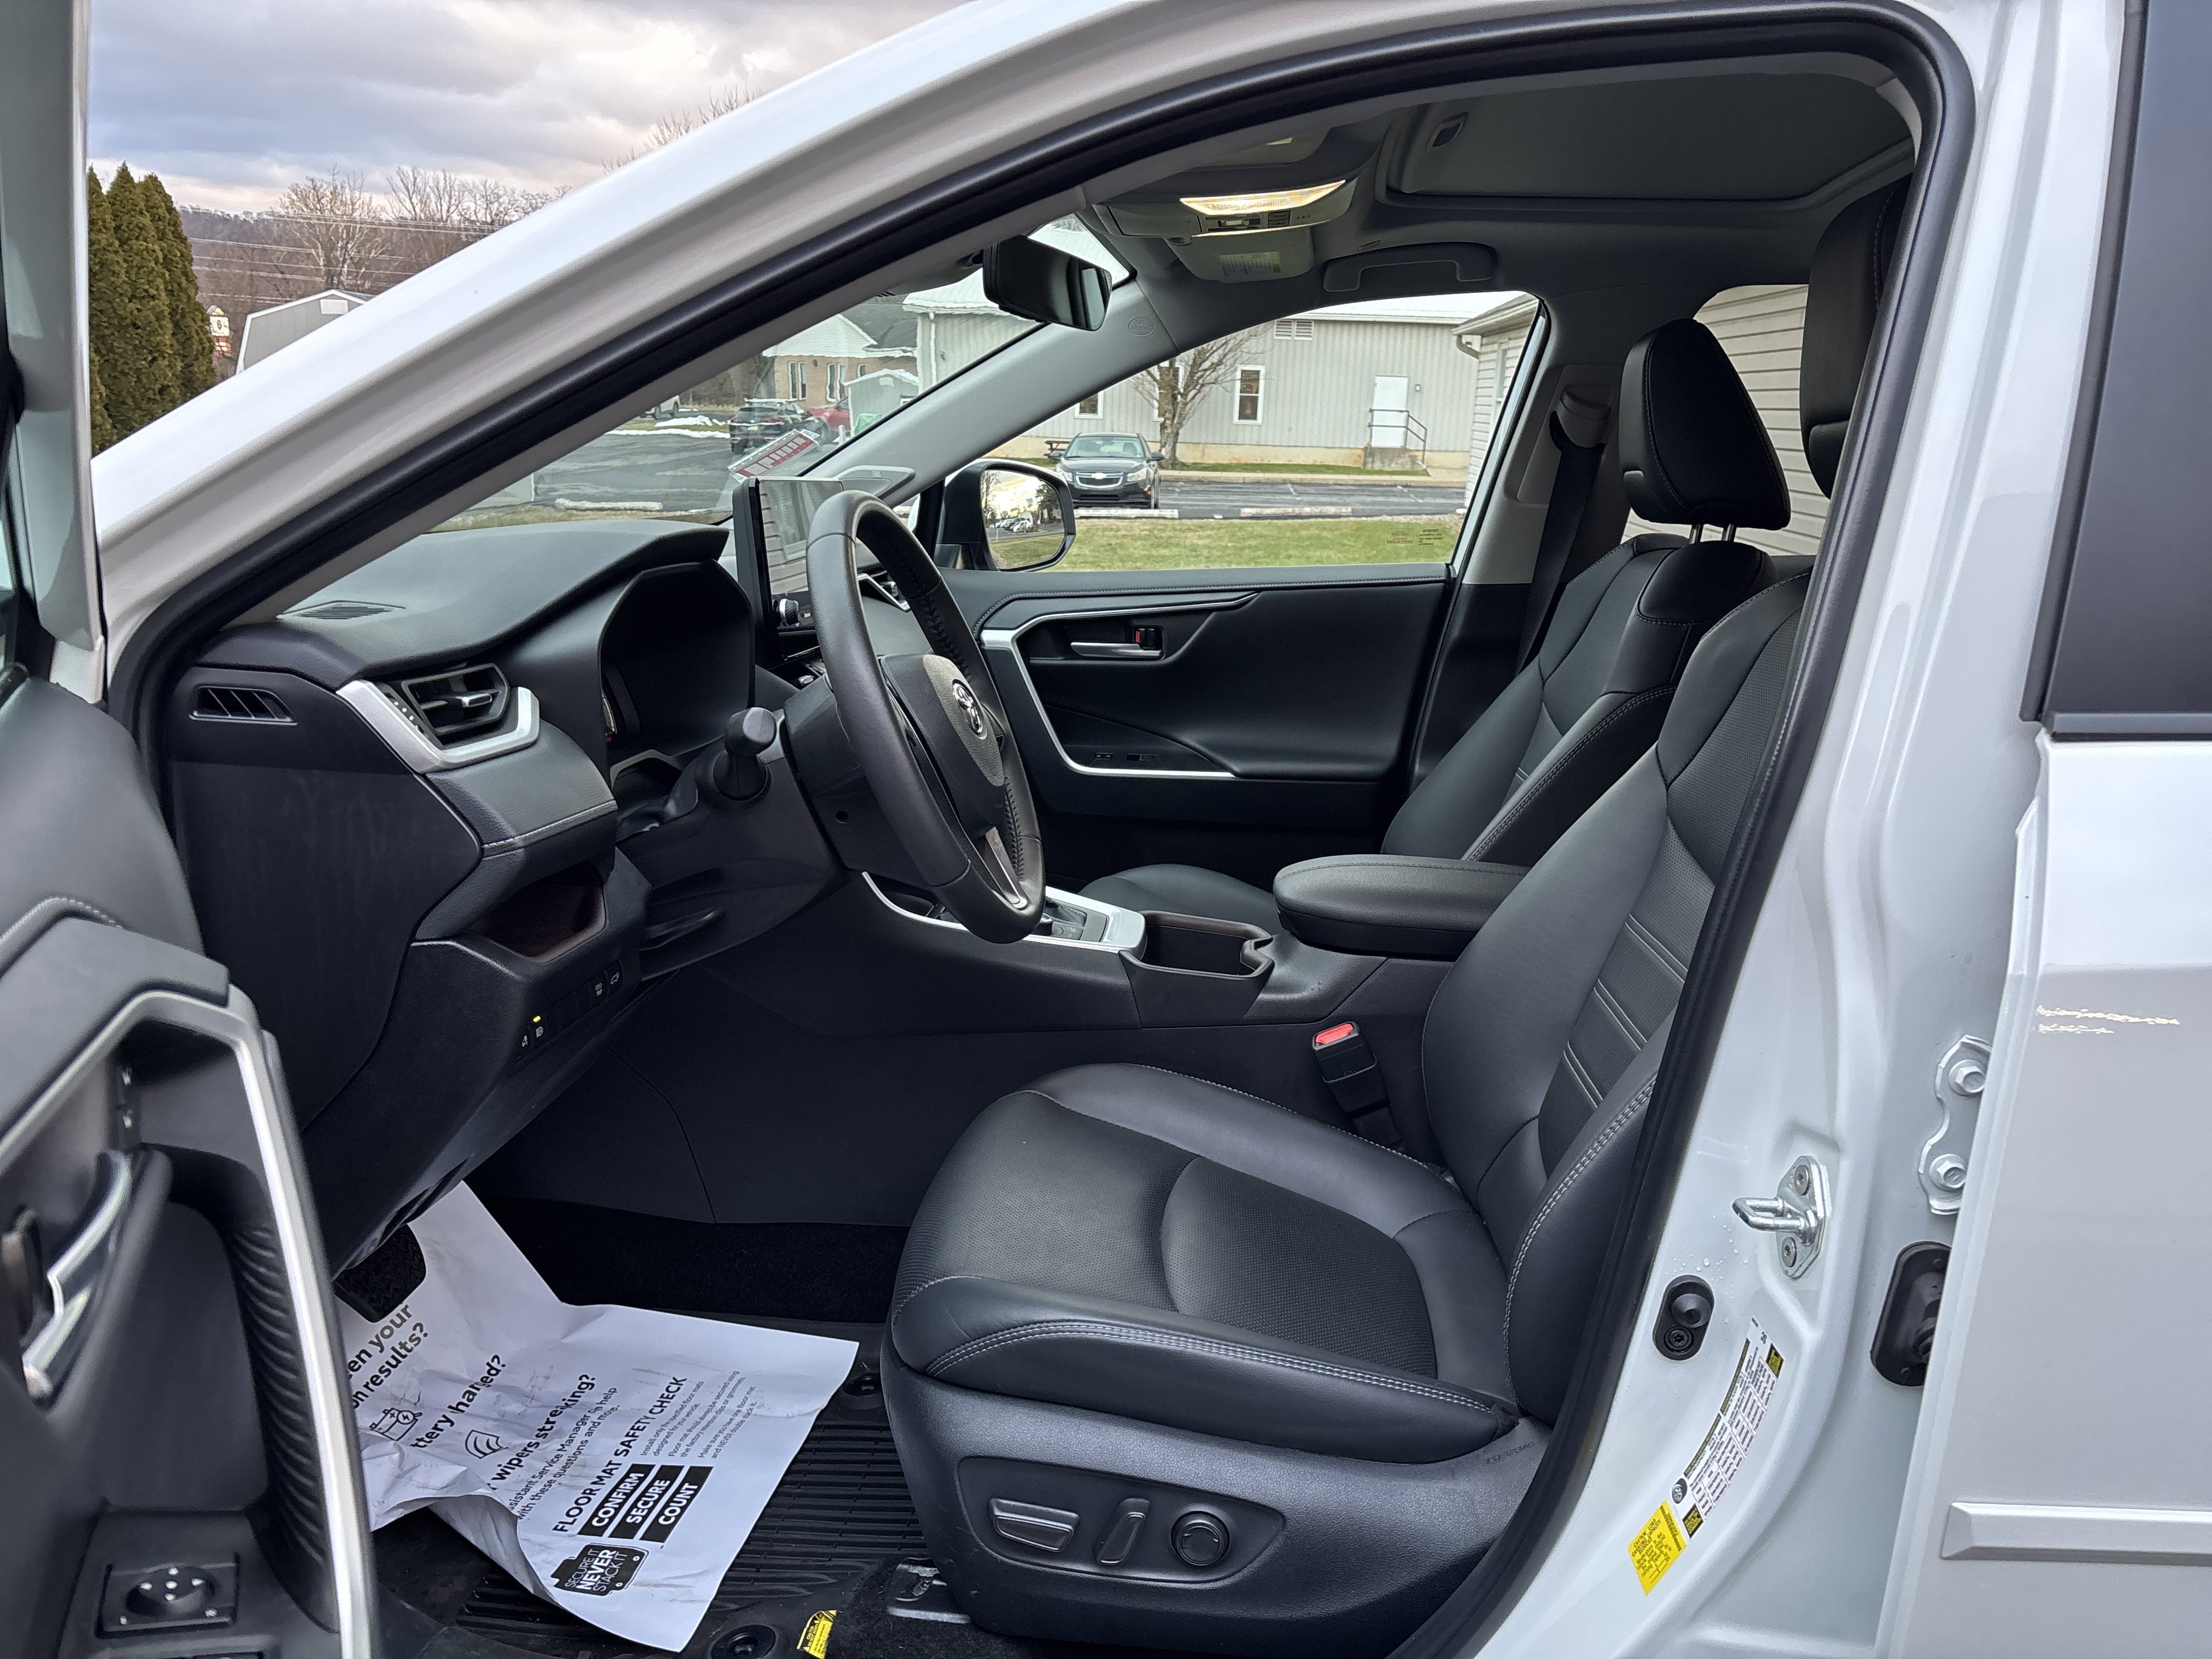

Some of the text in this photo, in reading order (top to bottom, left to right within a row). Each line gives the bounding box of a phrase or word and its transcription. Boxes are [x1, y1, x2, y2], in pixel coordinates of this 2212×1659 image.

[347, 1304, 412, 1380] en your
[363, 1322, 428, 1393] results?
[447, 1355, 506, 1414] hared?
[532, 1454, 563, 1479] Service
[556, 1414, 591, 1452] Manager
[596, 1387, 618, 1404] help
[552, 1376, 687, 1532] FLOOR MAT SAFETY CHECK
[640, 1438, 656, 1455] Install
[491, 1441, 540, 1481] wipers
[517, 1503, 536, 1520] with
[529, 1479, 556, 1500] these
[552, 1440, 589, 1478] questions
[584, 1421, 602, 1437] and
[591, 1473, 645, 1527] CONFIRM
[626, 1480, 670, 1523] SECURE
[658, 1482, 698, 1525] COUNT
[565, 1548, 600, 1588] SECURE IT
[575, 1549, 617, 1590] NEVER
[592, 1551, 628, 1592] STACK IT
